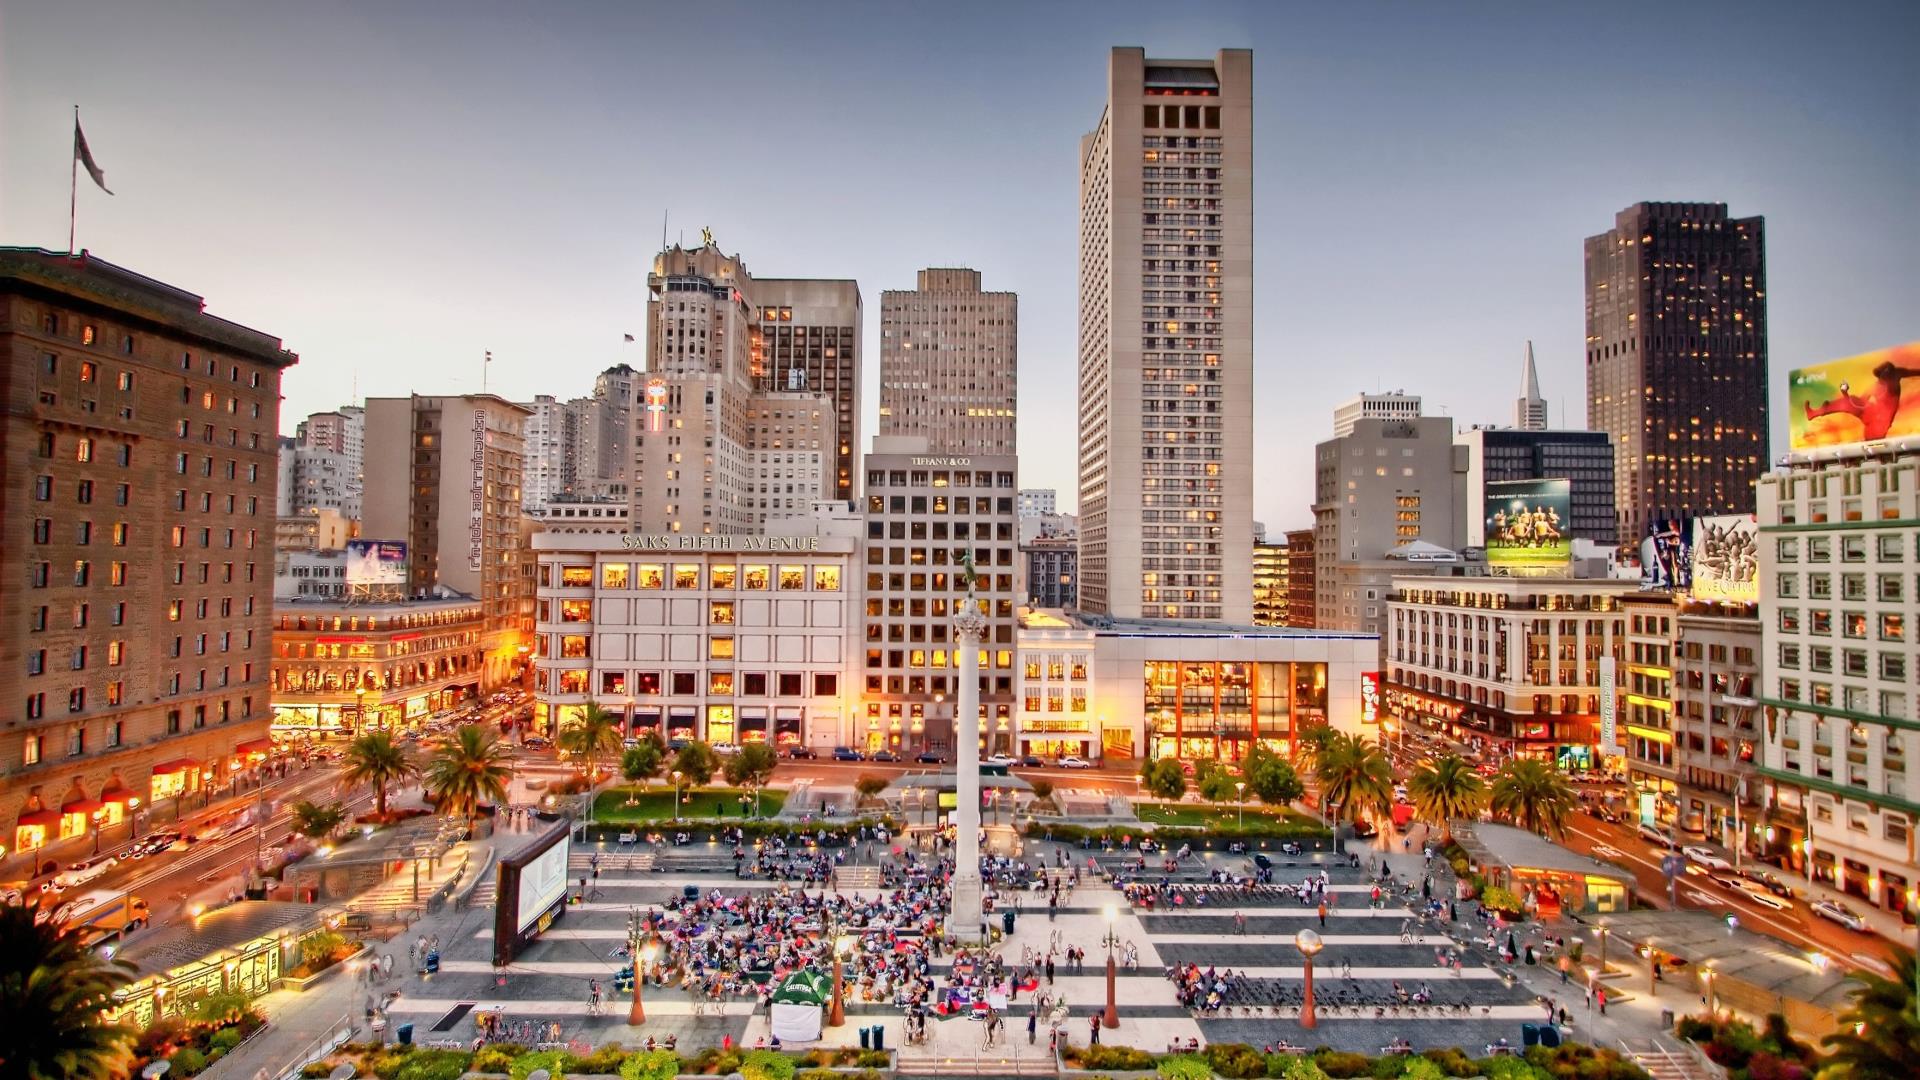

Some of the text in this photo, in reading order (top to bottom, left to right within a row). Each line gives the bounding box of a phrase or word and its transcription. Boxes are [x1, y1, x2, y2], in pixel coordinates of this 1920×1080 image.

[911, 457, 949, 466] TIFFANY
[949, 457, 956, 466] &
[471, 410, 485, 568] CHANCELLOR HOTEL
[621, 535, 819, 550] SAKS FIFTH AVENUE
